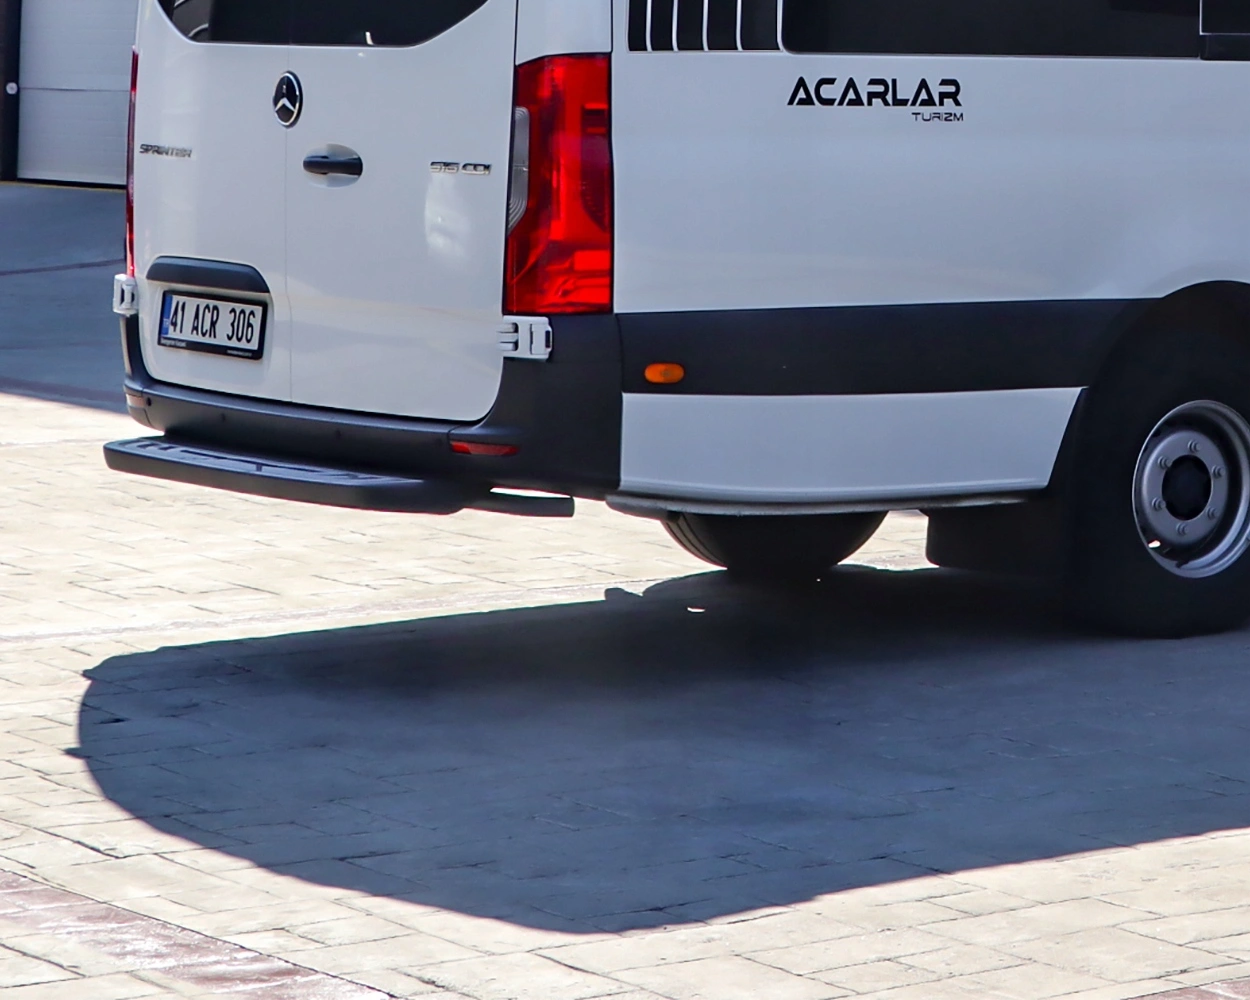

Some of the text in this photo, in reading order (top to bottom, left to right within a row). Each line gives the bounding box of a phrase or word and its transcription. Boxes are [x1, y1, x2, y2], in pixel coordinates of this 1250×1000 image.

[787, 76, 962, 106] ACARLAR
[171, 301, 255, 343] 41 ACR 306
